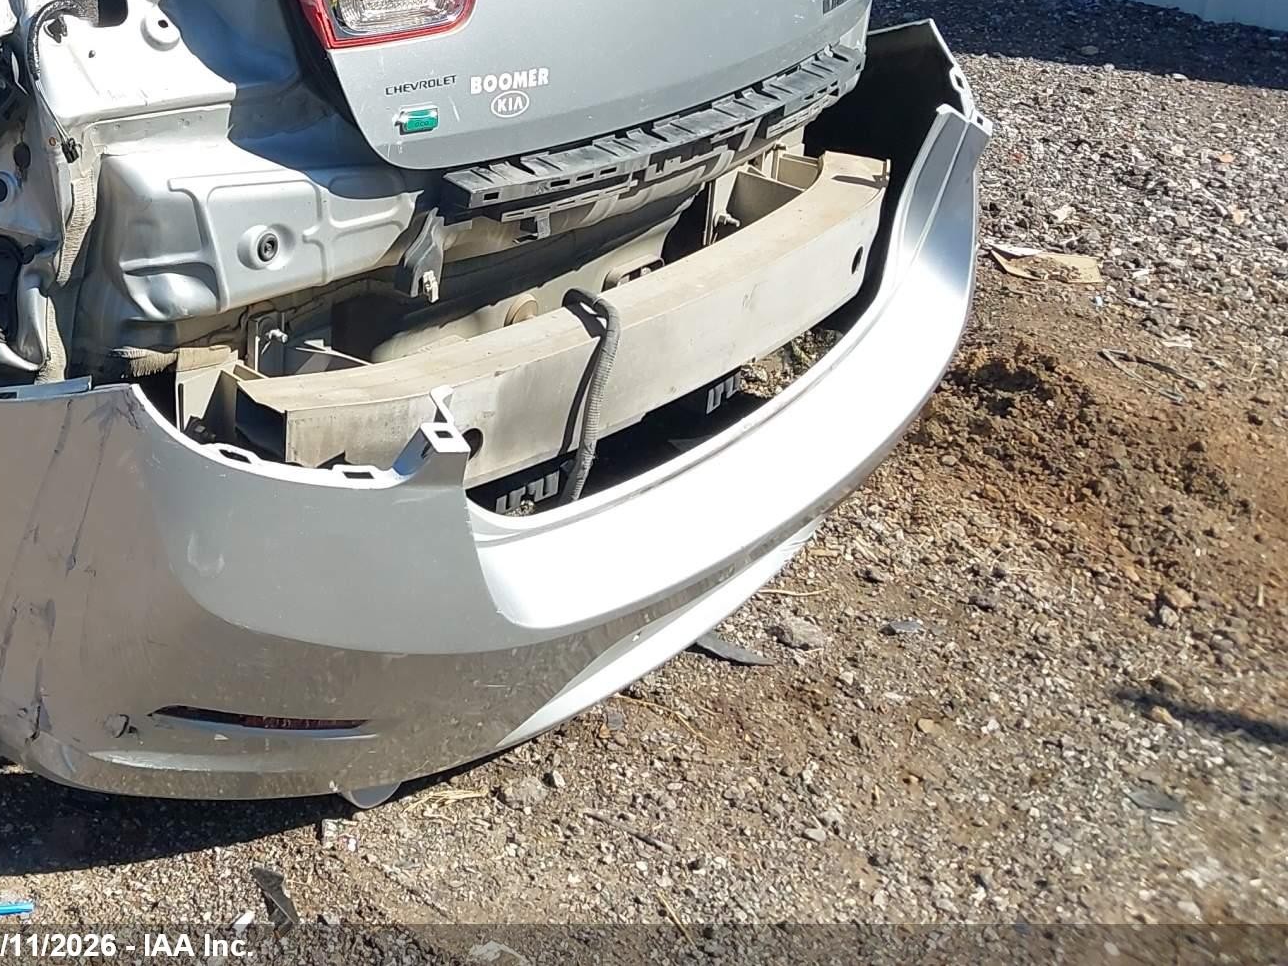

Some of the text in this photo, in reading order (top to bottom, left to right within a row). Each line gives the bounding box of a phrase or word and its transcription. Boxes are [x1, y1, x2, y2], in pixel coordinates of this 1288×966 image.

[385, 75, 457, 96] CHEVROLET
[470, 68, 549, 94] BOOMER
[497, 97, 524, 113] KIA
